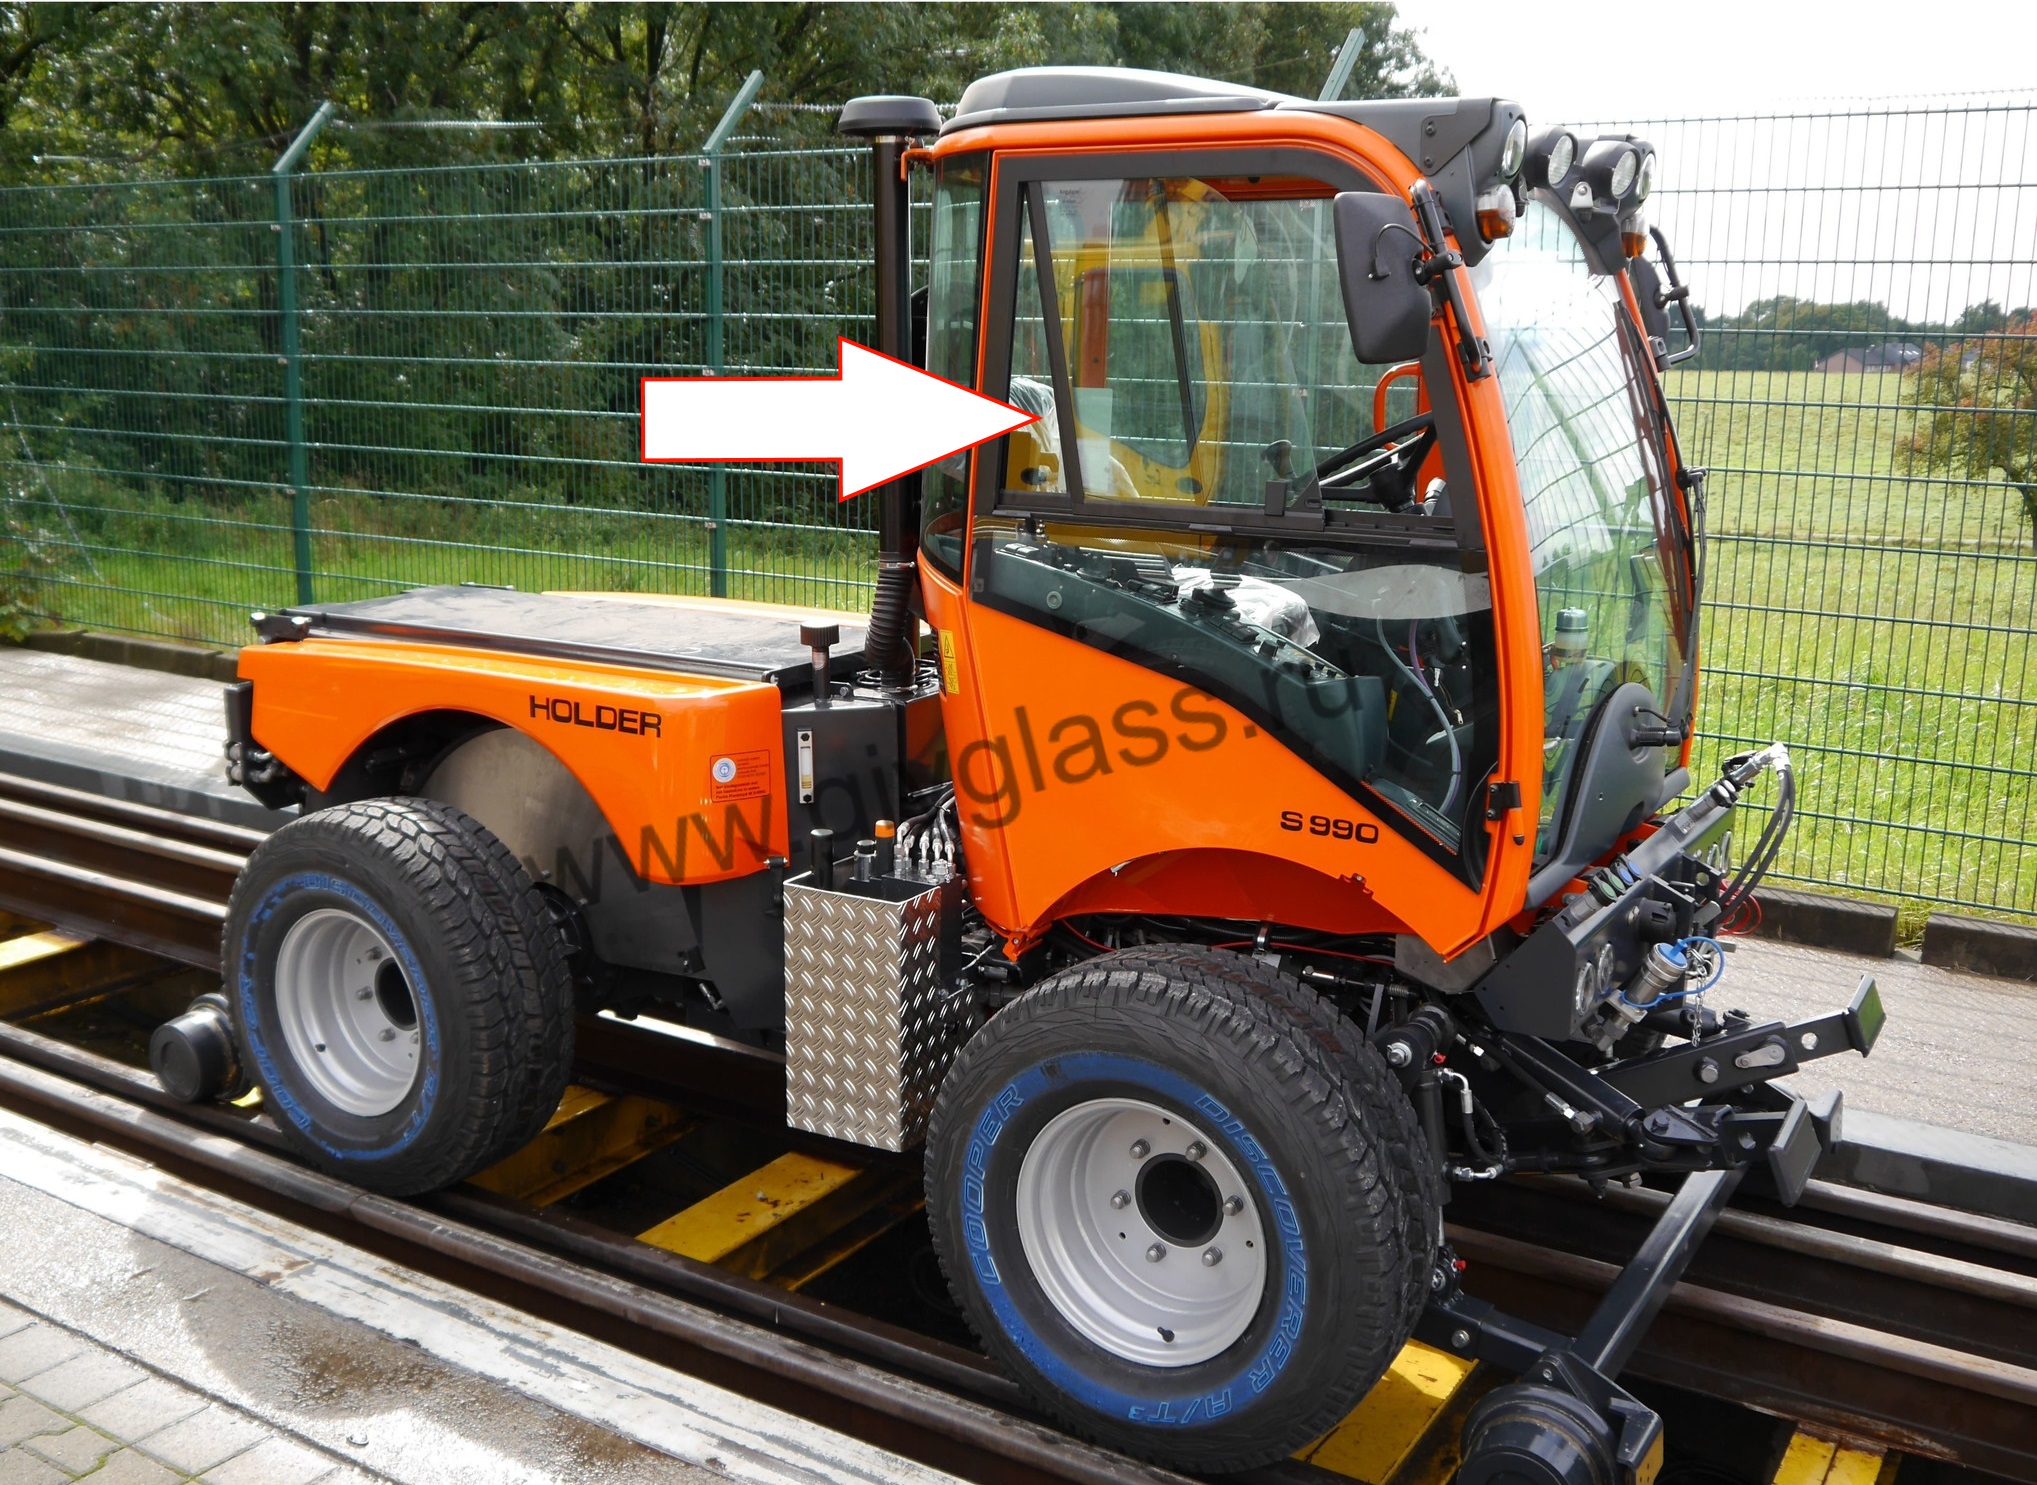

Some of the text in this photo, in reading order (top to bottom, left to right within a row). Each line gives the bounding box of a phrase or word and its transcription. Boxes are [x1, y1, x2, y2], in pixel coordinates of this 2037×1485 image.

[529, 694, 662, 738] HOLDER
[1280, 810, 1379, 845] S 990
[962, 1083, 1024, 1286] COOPER
[1194, 1094, 1307, 1394] DISCOVERER
